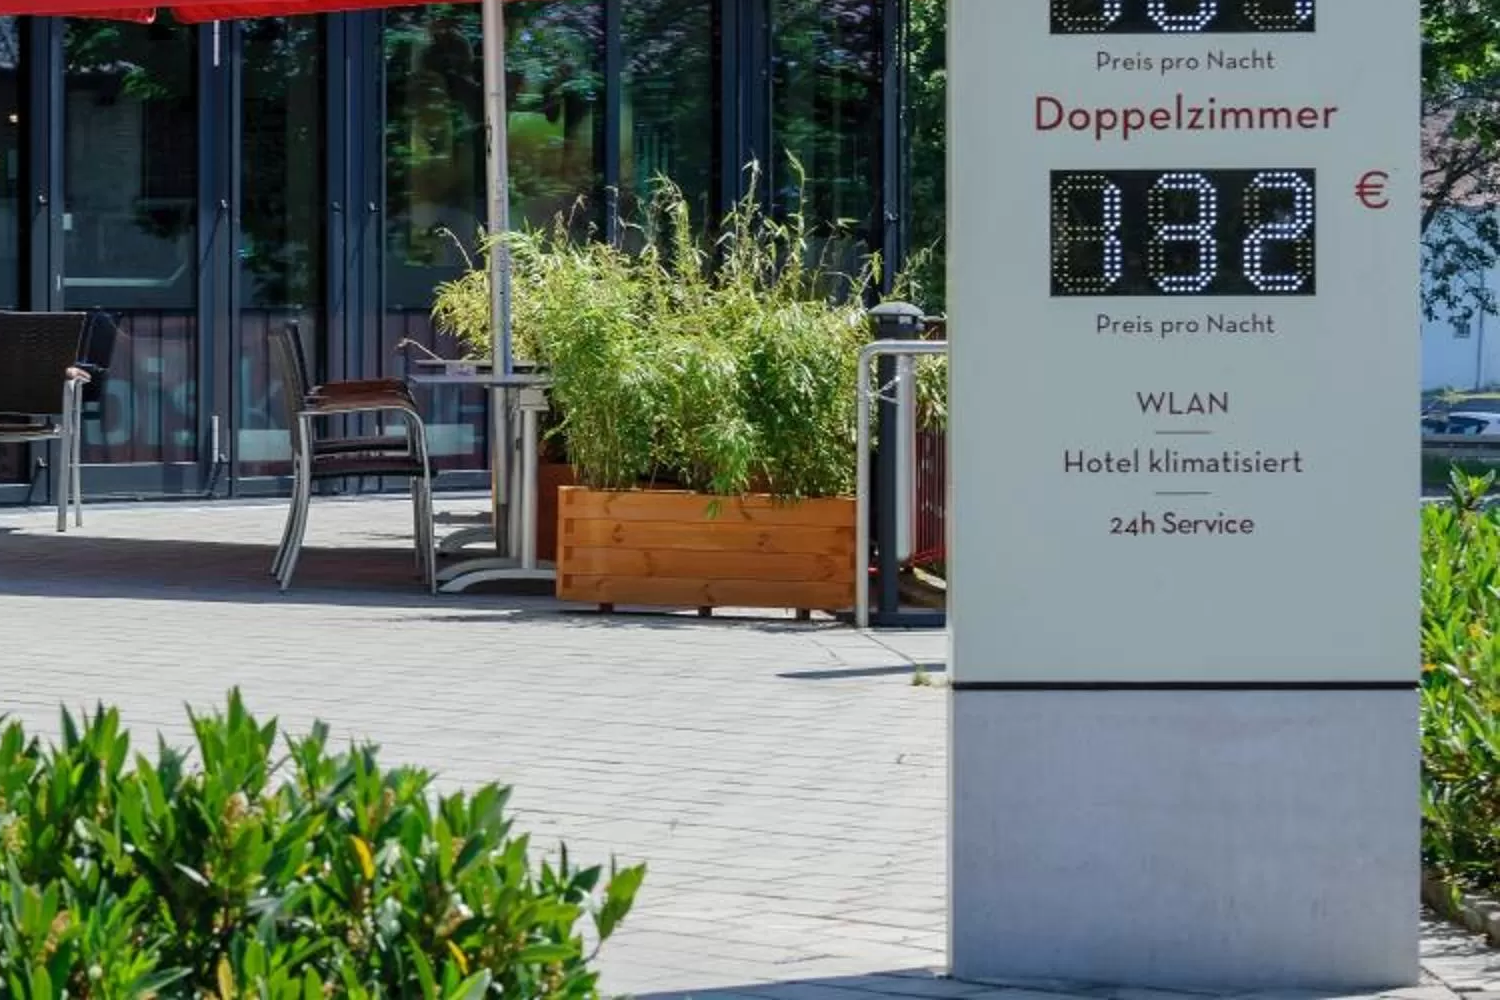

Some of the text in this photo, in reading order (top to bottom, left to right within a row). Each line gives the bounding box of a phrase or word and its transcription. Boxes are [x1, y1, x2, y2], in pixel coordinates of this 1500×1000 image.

[1096, 49, 1276, 76] Preis pro Nacht
[1035, 93, 1338, 140] Doppelzimmer
[1103, 171, 1389, 292] 132 €
[1096, 314, 1275, 339] Preis pro Nacht
[1136, 391, 1229, 415] WLAN
[1063, 449, 1304, 474] Hotel klimatisiert
[1110, 512, 1254, 537] 24h Service
